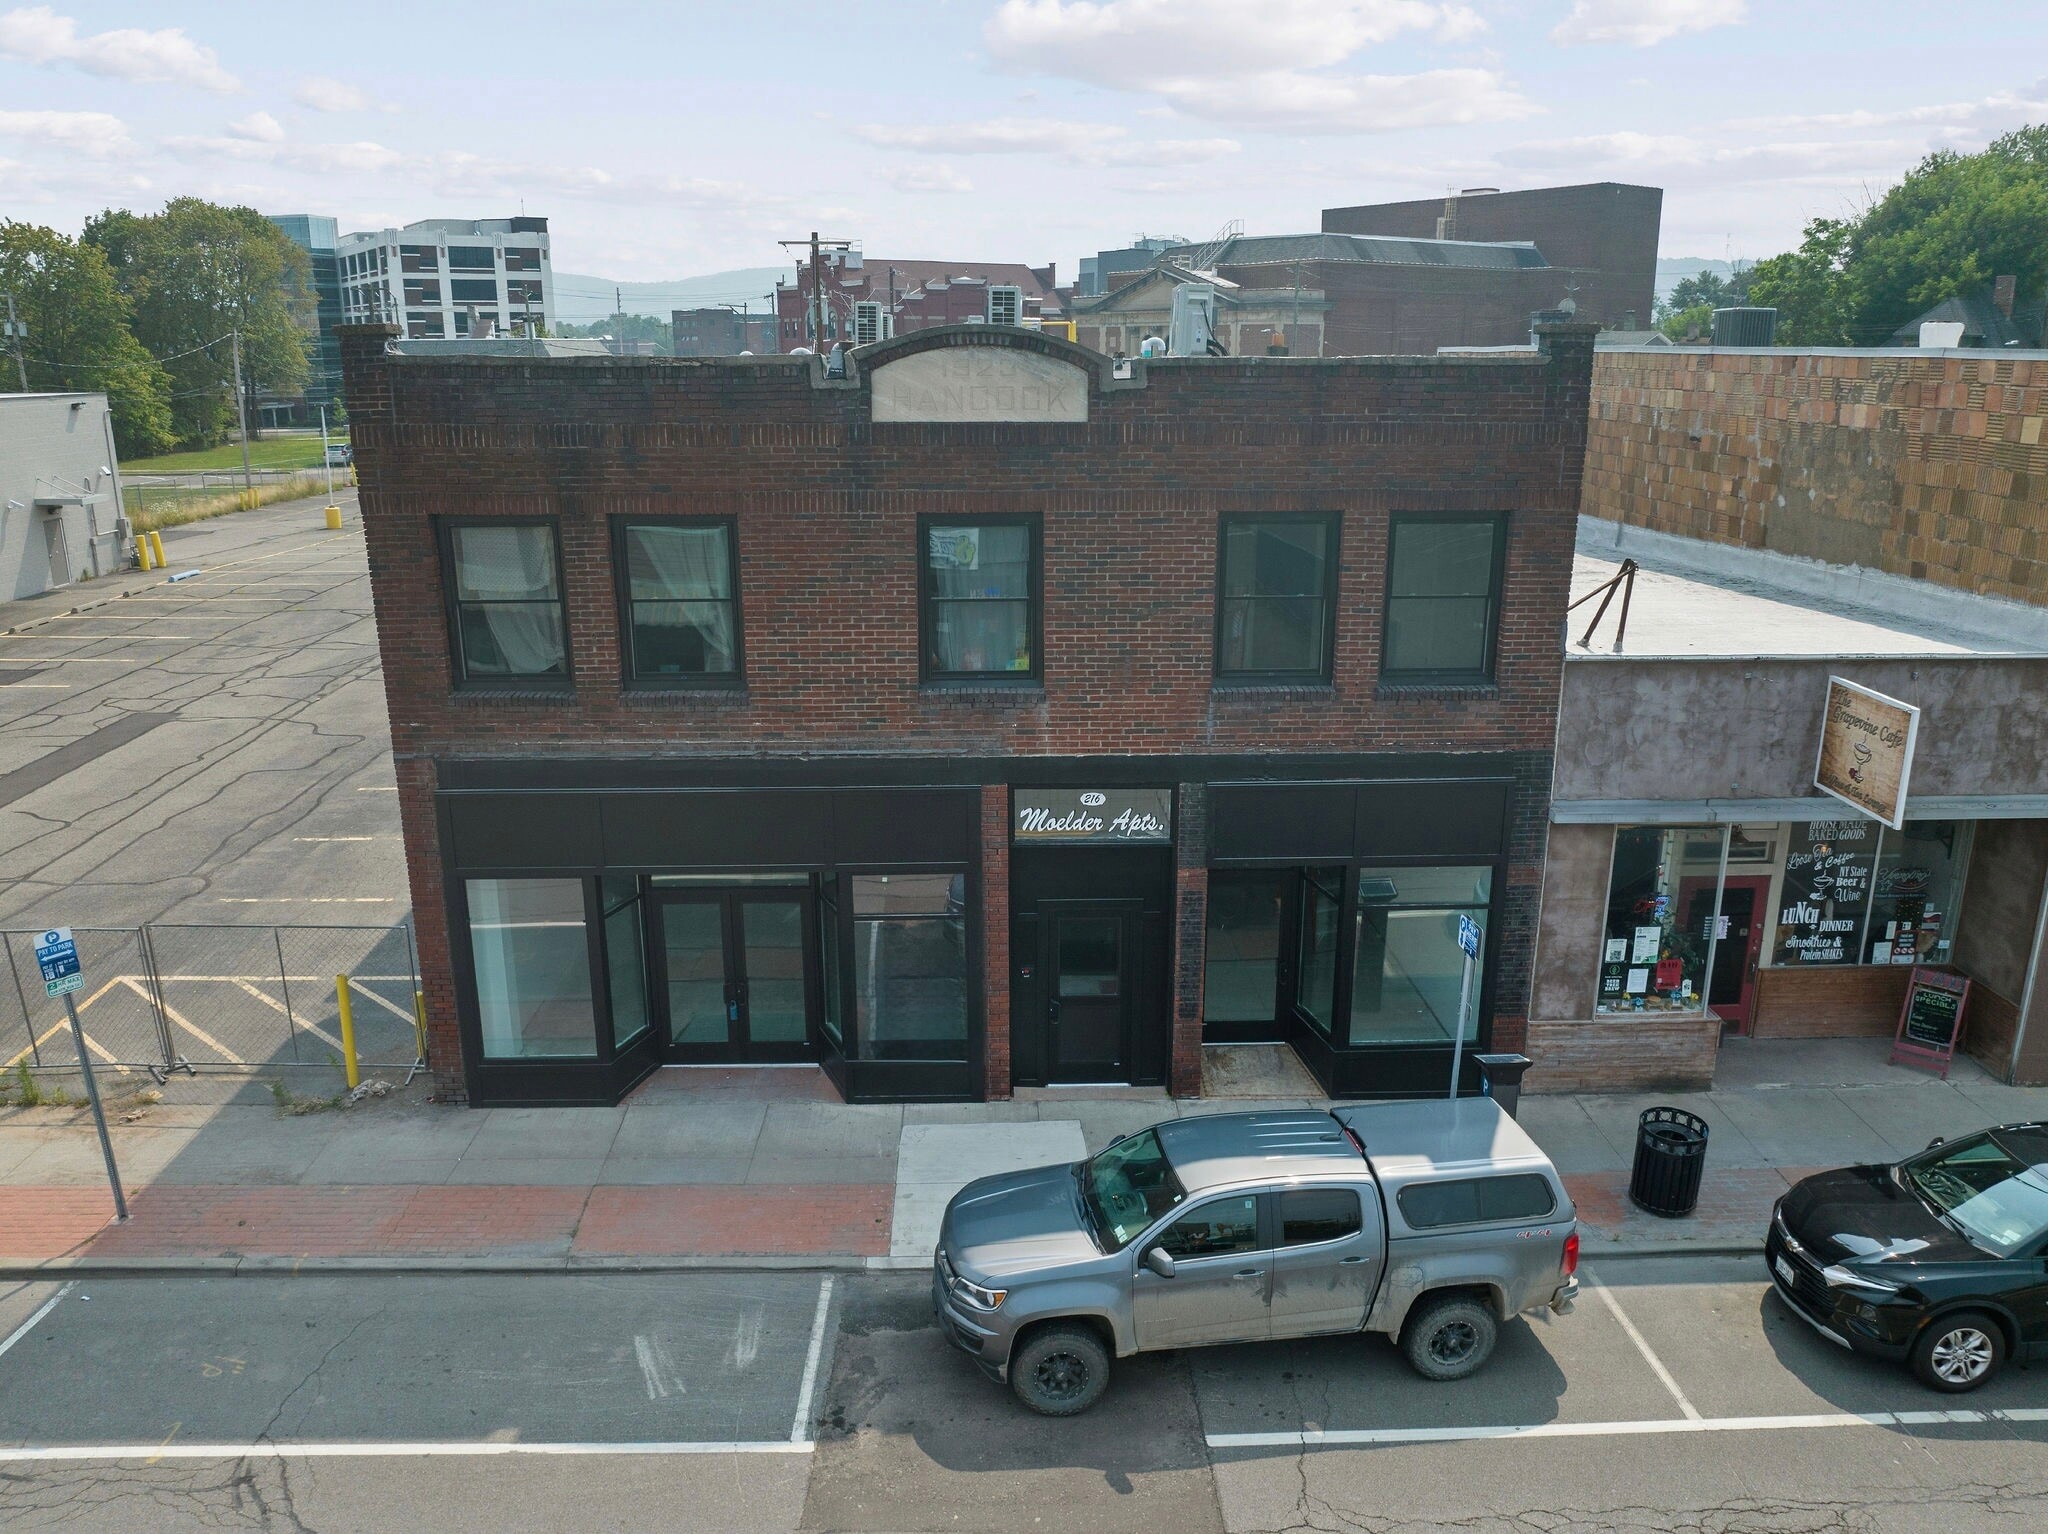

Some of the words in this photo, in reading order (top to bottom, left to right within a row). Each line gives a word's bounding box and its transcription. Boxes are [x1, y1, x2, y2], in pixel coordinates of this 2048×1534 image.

[892, 385, 1067, 412] HANCOCK
[1832, 705, 1878, 735] Grapevine
[1880, 725, 1903, 748] Cafe
[1084, 794, 1101, 804] 216
[1020, 807, 1104, 832] Moelder
[1109, 807, 1164, 837] Apts.
[1808, 829, 1839, 841] BAKED
[1839, 829, 1867, 840] GOODS
[1787, 851, 1813, 870] Loose
[1814, 860, 1823, 871] &
[1825, 852, 1855, 868] Coffee
[1839, 866, 1850, 877] NY
[1850, 866, 1868, 877] State
[1835, 877, 1858, 887] Beer
[1859, 878, 1866, 889] &
[1834, 887, 1861, 902] Wine
[1781, 901, 1820, 924] LUNCH
[1819, 920, 1854, 932] DINNER
[48, 932, 57, 943] P
[1785, 935, 1831, 948] Smoothies
[1833, 936, 1842, 947] &
[37, 947, 49, 957] PAY
[50, 945, 58, 953] TO
[58, 941, 74, 951] PARK
[1800, 949, 1821, 960] Protein
[1821, 948, 1844, 960] SHAKES
